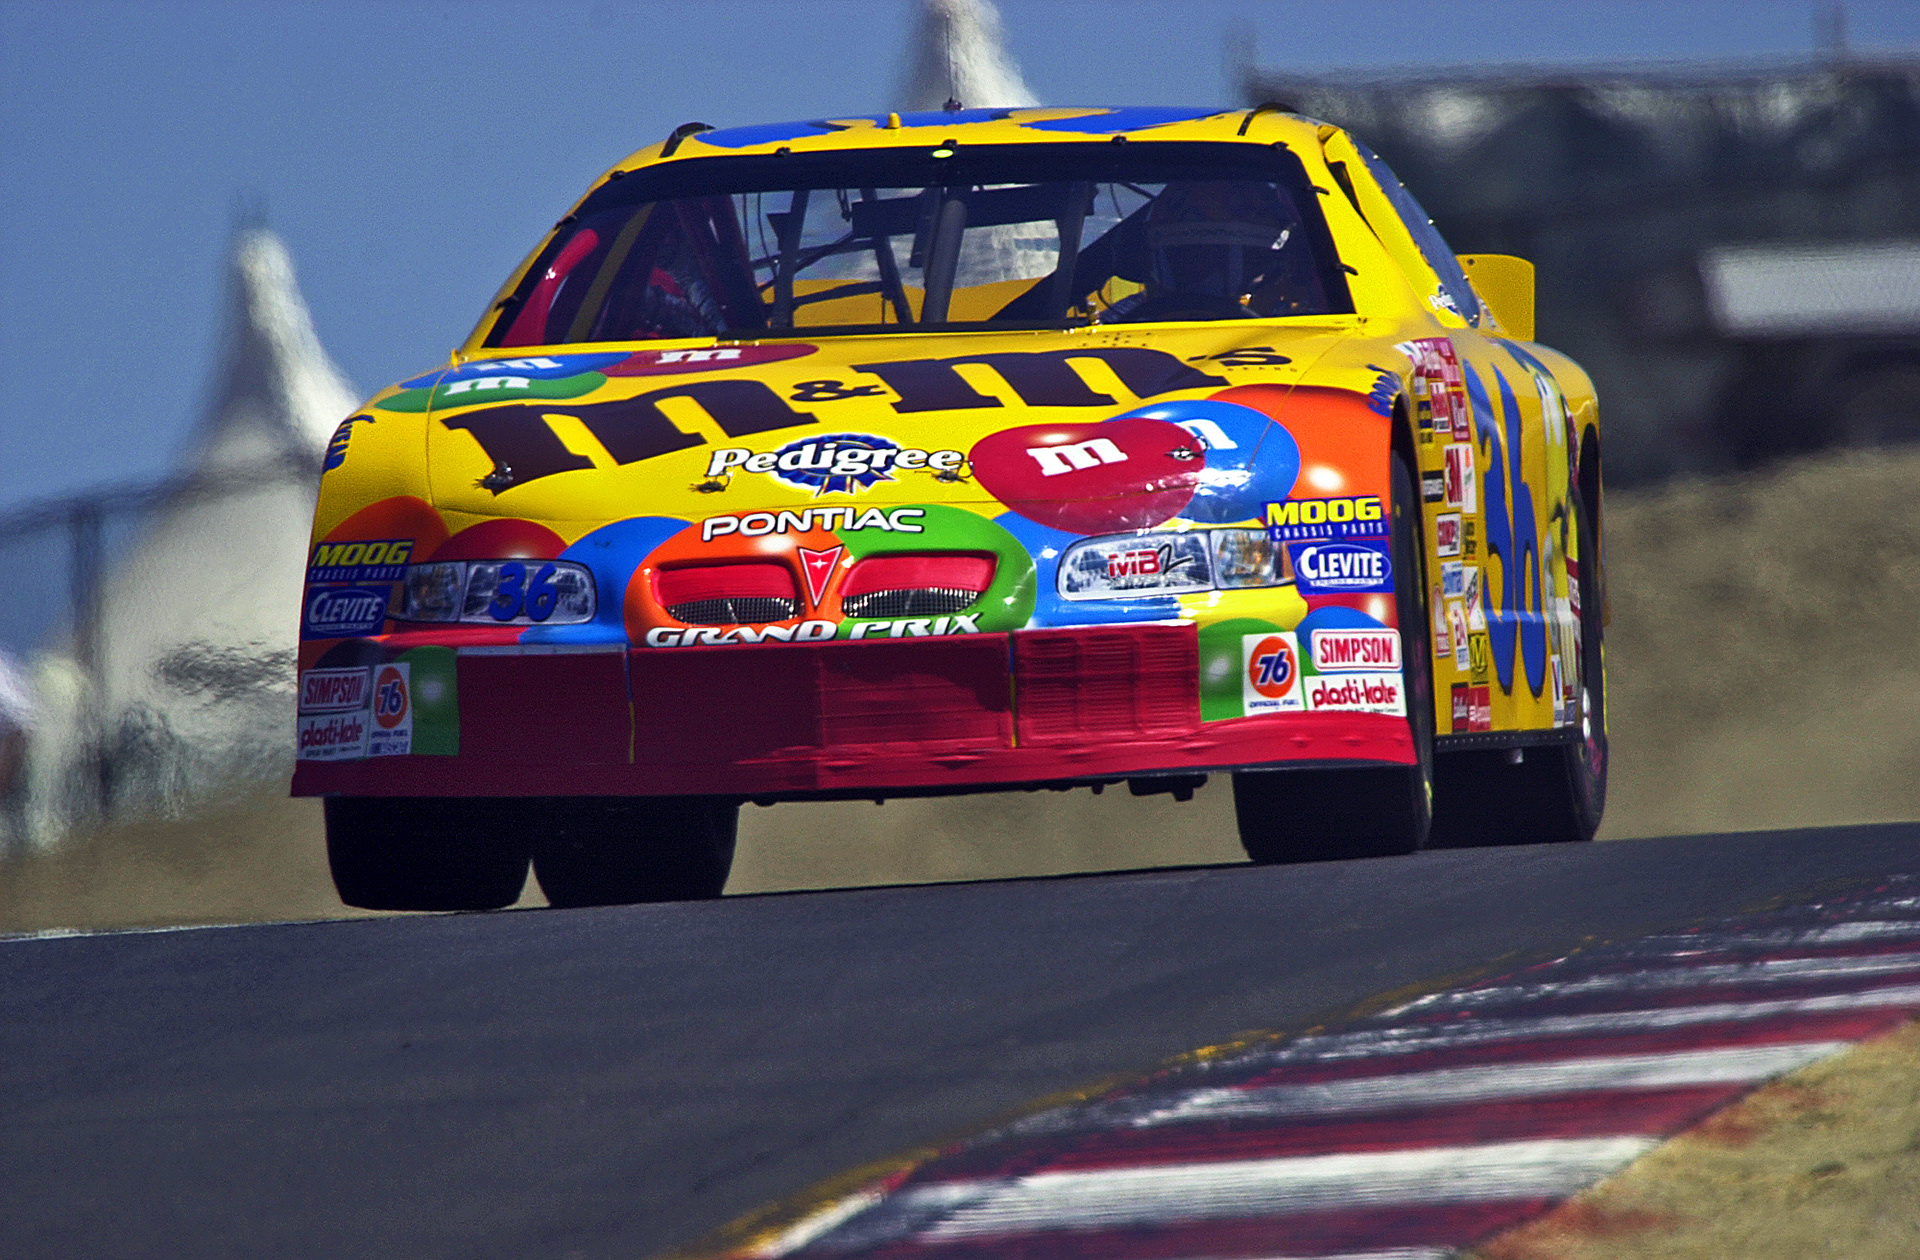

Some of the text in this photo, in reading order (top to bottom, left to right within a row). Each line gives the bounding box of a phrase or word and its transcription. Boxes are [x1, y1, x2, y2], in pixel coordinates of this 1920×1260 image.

[444, 376, 531, 396] m
[704, 442, 966, 477] Pedigree
[1026, 438, 1129, 477] m
[701, 507, 926, 542] PONTIAC
[1266, 497, 1382, 527] MOOG
[1274, 522, 1384, 539] CHASSIS PARTS
[310, 541, 414, 567] MOOG
[1300, 546, 1383, 579] CLEVITE
[308, 591, 384, 623] CLEVITE
[488, 561, 558, 622] 36
[645, 612, 984, 648] GRAND PRIX
[1255, 648, 1291, 686] 76
[1319, 637, 1394, 664] SIMPSON
[377, 678, 404, 717] 76
[1312, 677, 1398, 708] plasti-kote
